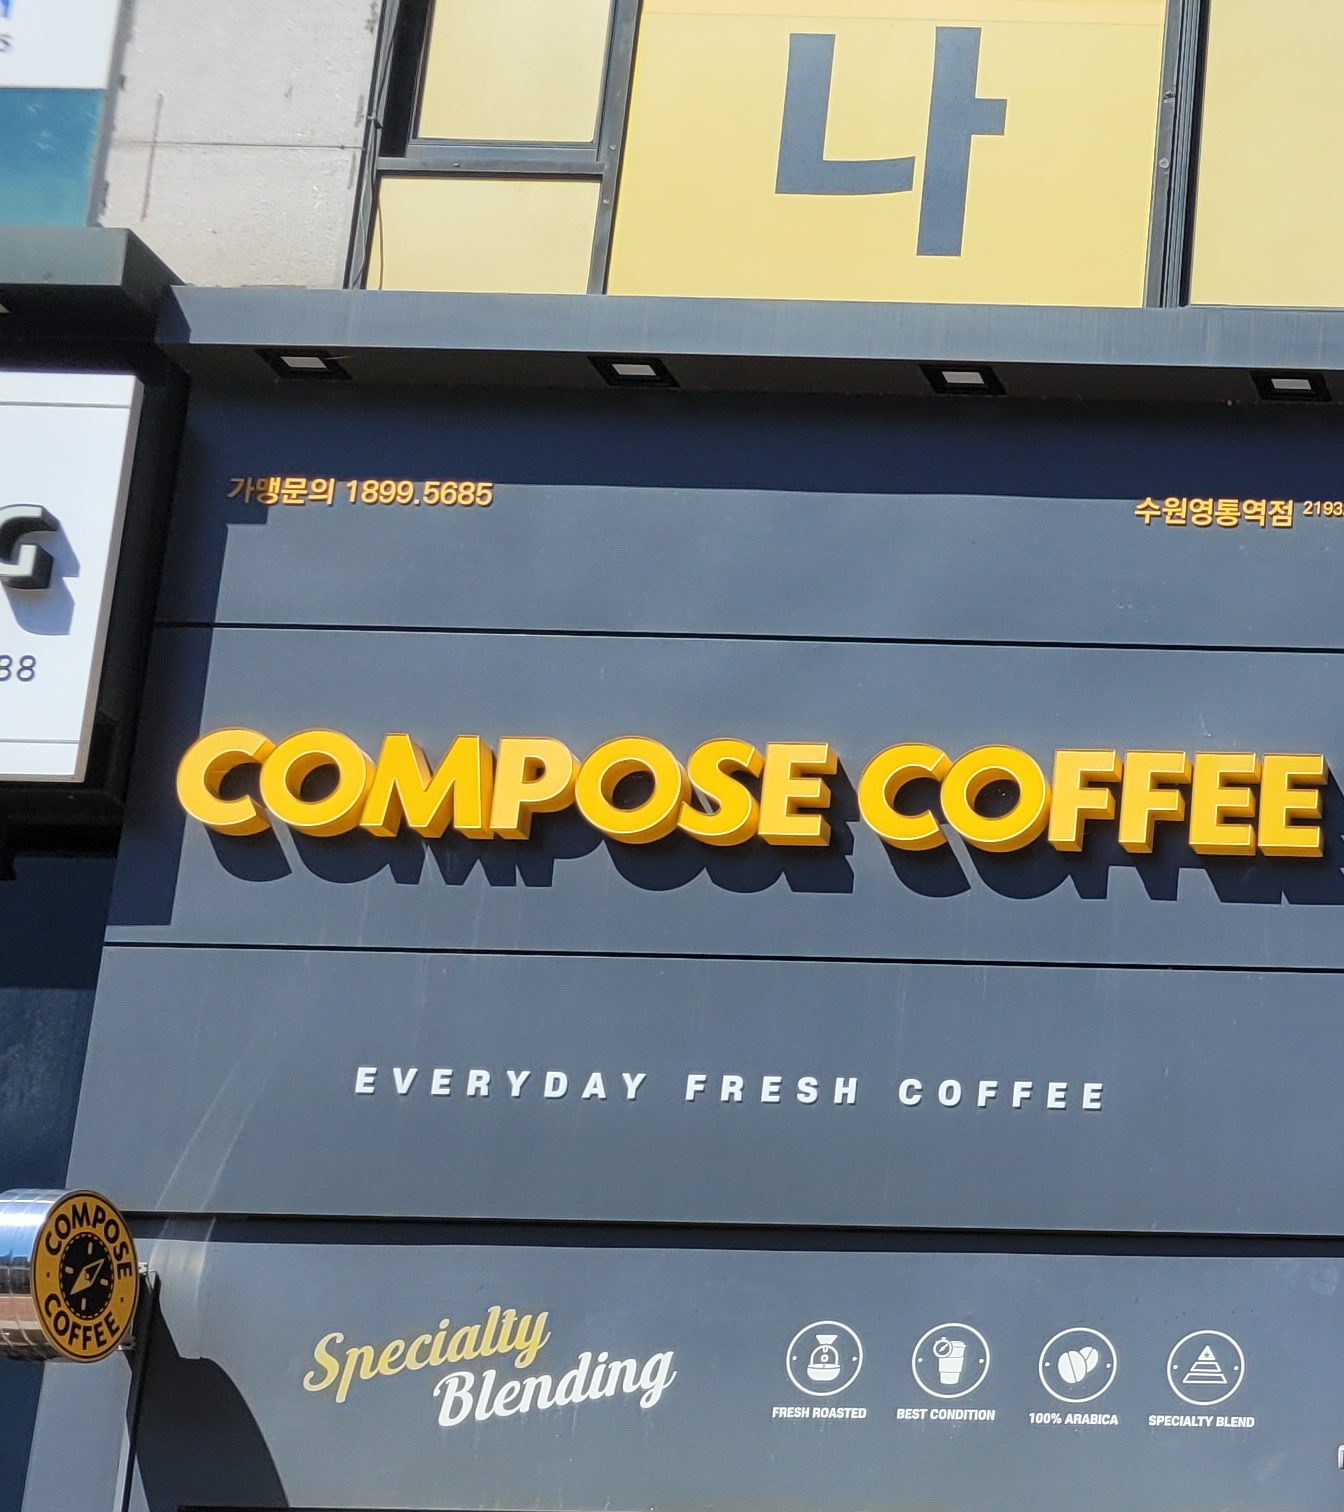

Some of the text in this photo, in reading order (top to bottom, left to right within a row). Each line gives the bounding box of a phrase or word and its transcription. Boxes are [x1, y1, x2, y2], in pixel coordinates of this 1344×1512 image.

[775, 26, 1007, 256] 나
[228, 476, 495, 507] 가맹문의 1899.5685
[1134, 497, 1294, 527] 수원영통역점
[177, 726, 1327, 859] COMPOSE COFFEE
[354, 1065, 1107, 1111] EVERYDAY FRESH COFFEE
[45, 1202, 132, 1280] COMPOSE
[44, 1293, 120, 1350] COFFEE
[303, 1306, 551, 1403] Specialty
[433, 1351, 677, 1427] Blending
[772, 1407, 867, 1419] FRESH ROASTED
[897, 1408, 995, 1421] BEST CONDITION
[1029, 1413, 1119, 1426] 100% ARABICA
[1148, 1415, 1255, 1428] SPECIALTY BLEND
